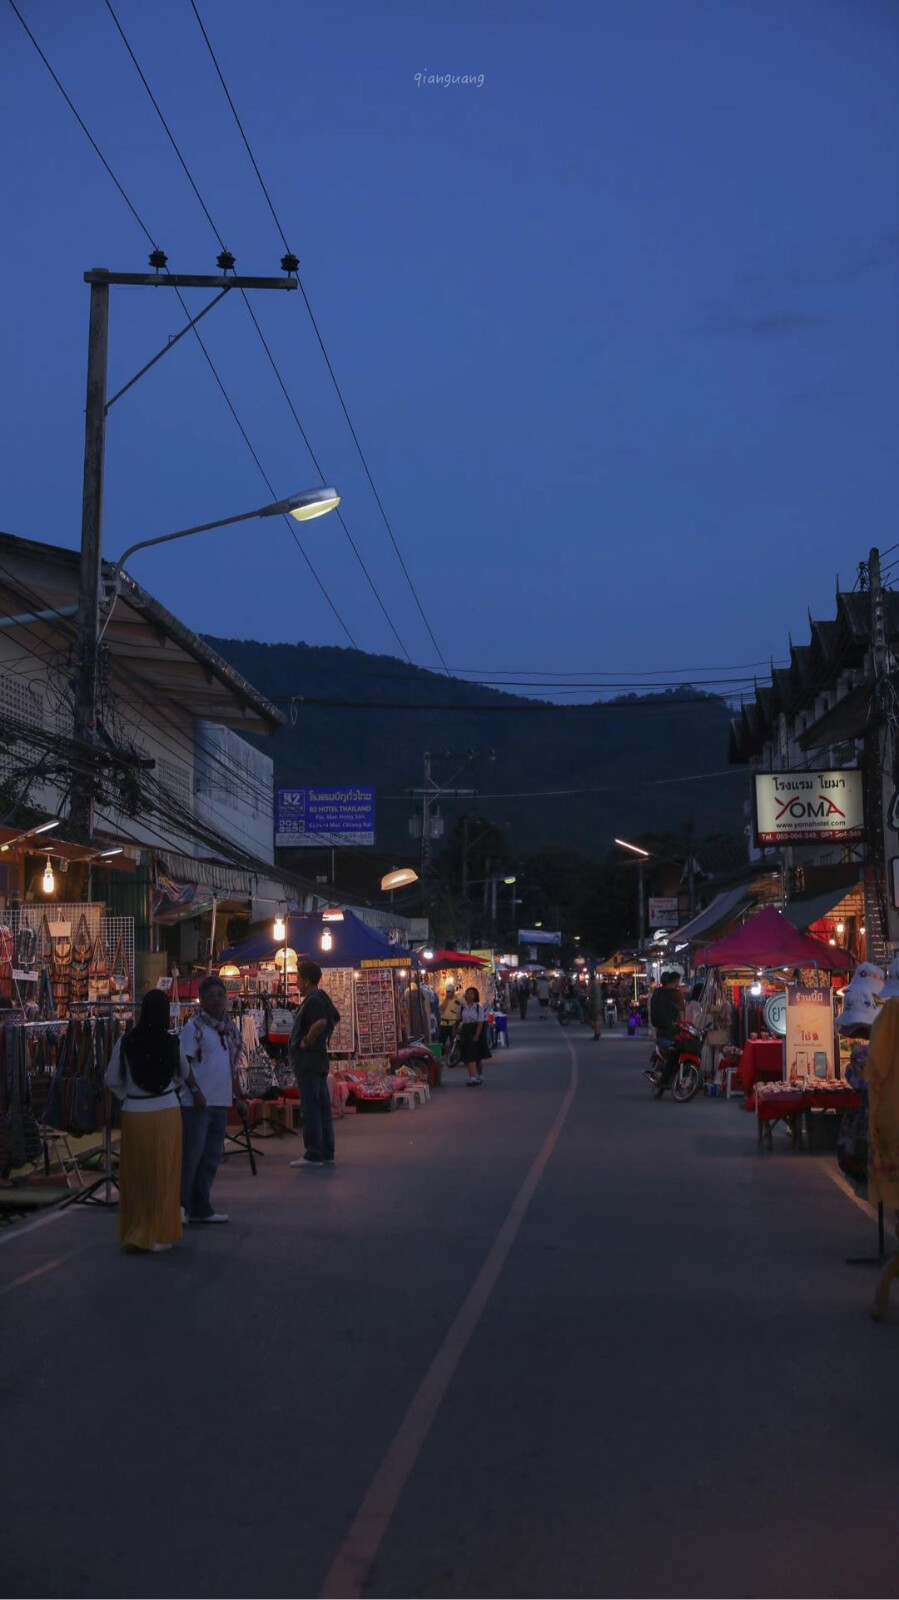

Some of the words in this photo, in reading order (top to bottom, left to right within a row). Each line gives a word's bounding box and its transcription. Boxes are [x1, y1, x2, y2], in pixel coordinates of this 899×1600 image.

[772, 777, 813, 791] โรงแรม
[818, 774, 846, 789] โยมา
[340, 805, 371, 813] THAILAND
[774, 795, 846, 821] YOMA
[776, 820, 846, 829] www.yomahotel.com
